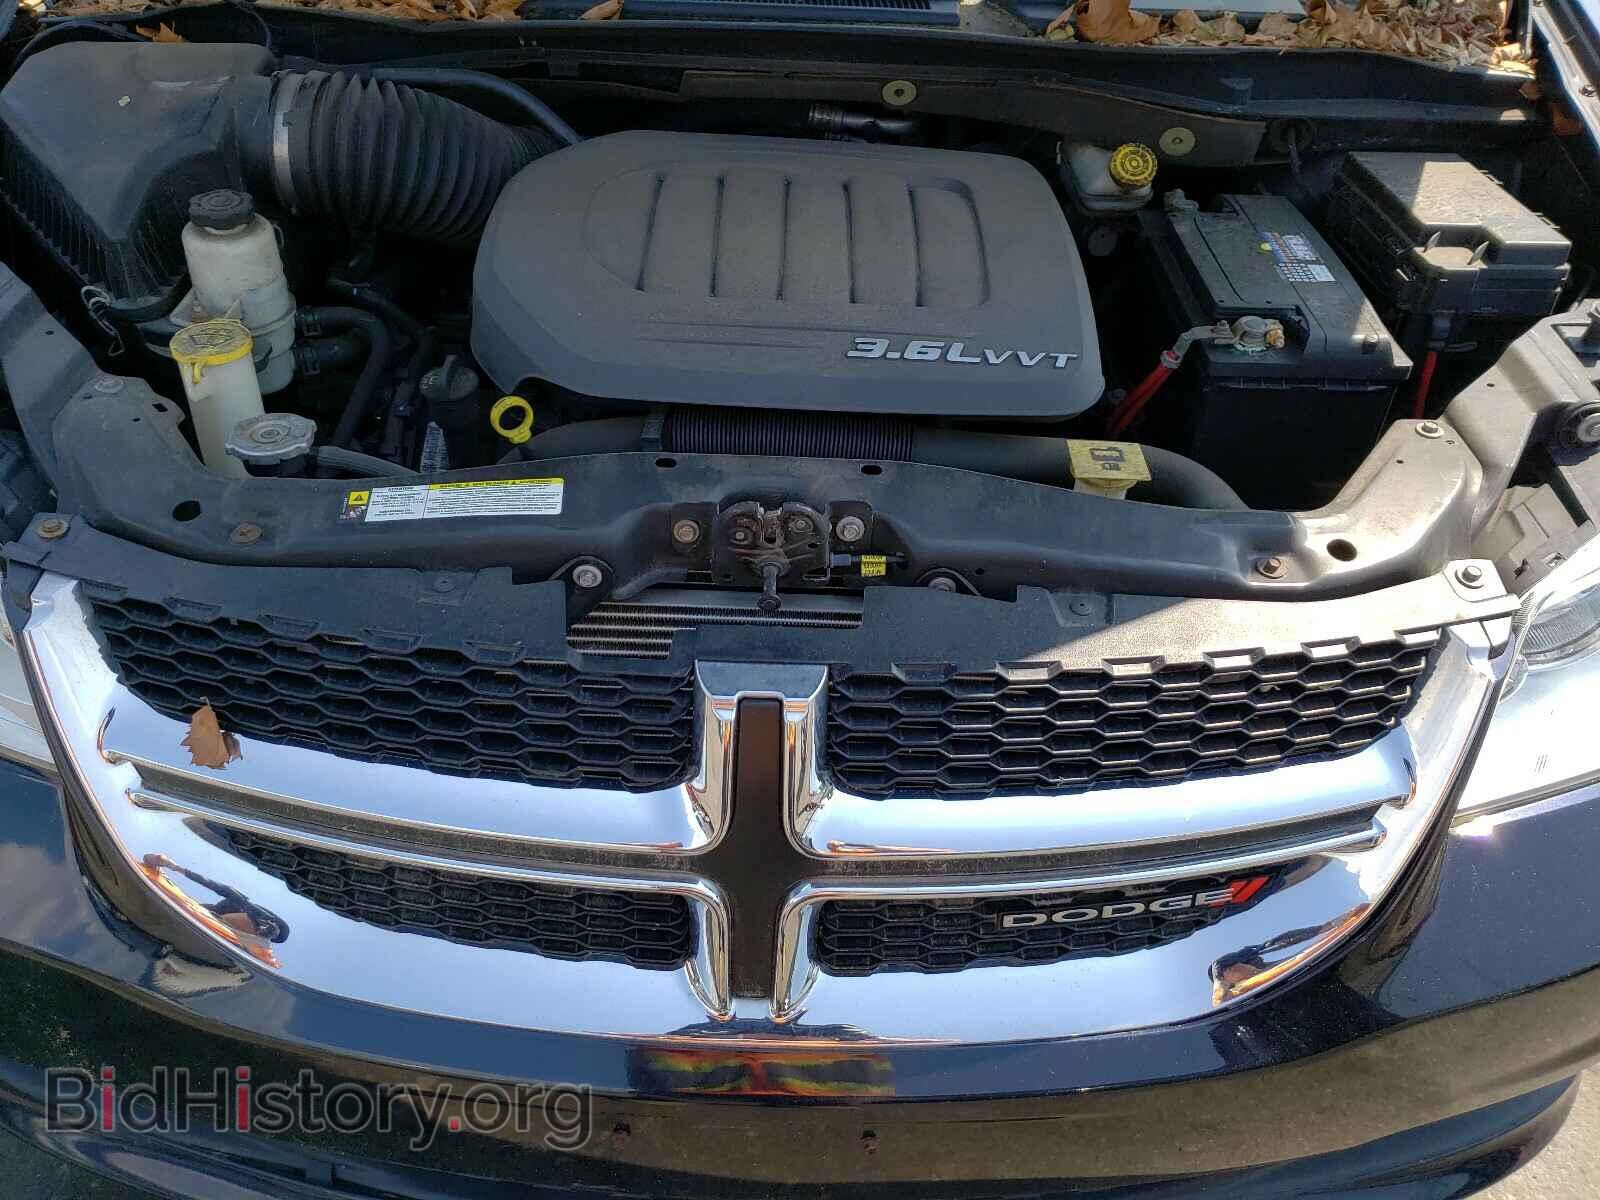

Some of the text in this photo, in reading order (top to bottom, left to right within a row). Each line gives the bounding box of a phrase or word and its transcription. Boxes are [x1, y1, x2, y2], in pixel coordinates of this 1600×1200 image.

[847, 337, 1078, 369] 3.6L VVT
[1001, 888, 1234, 929] DODGE
